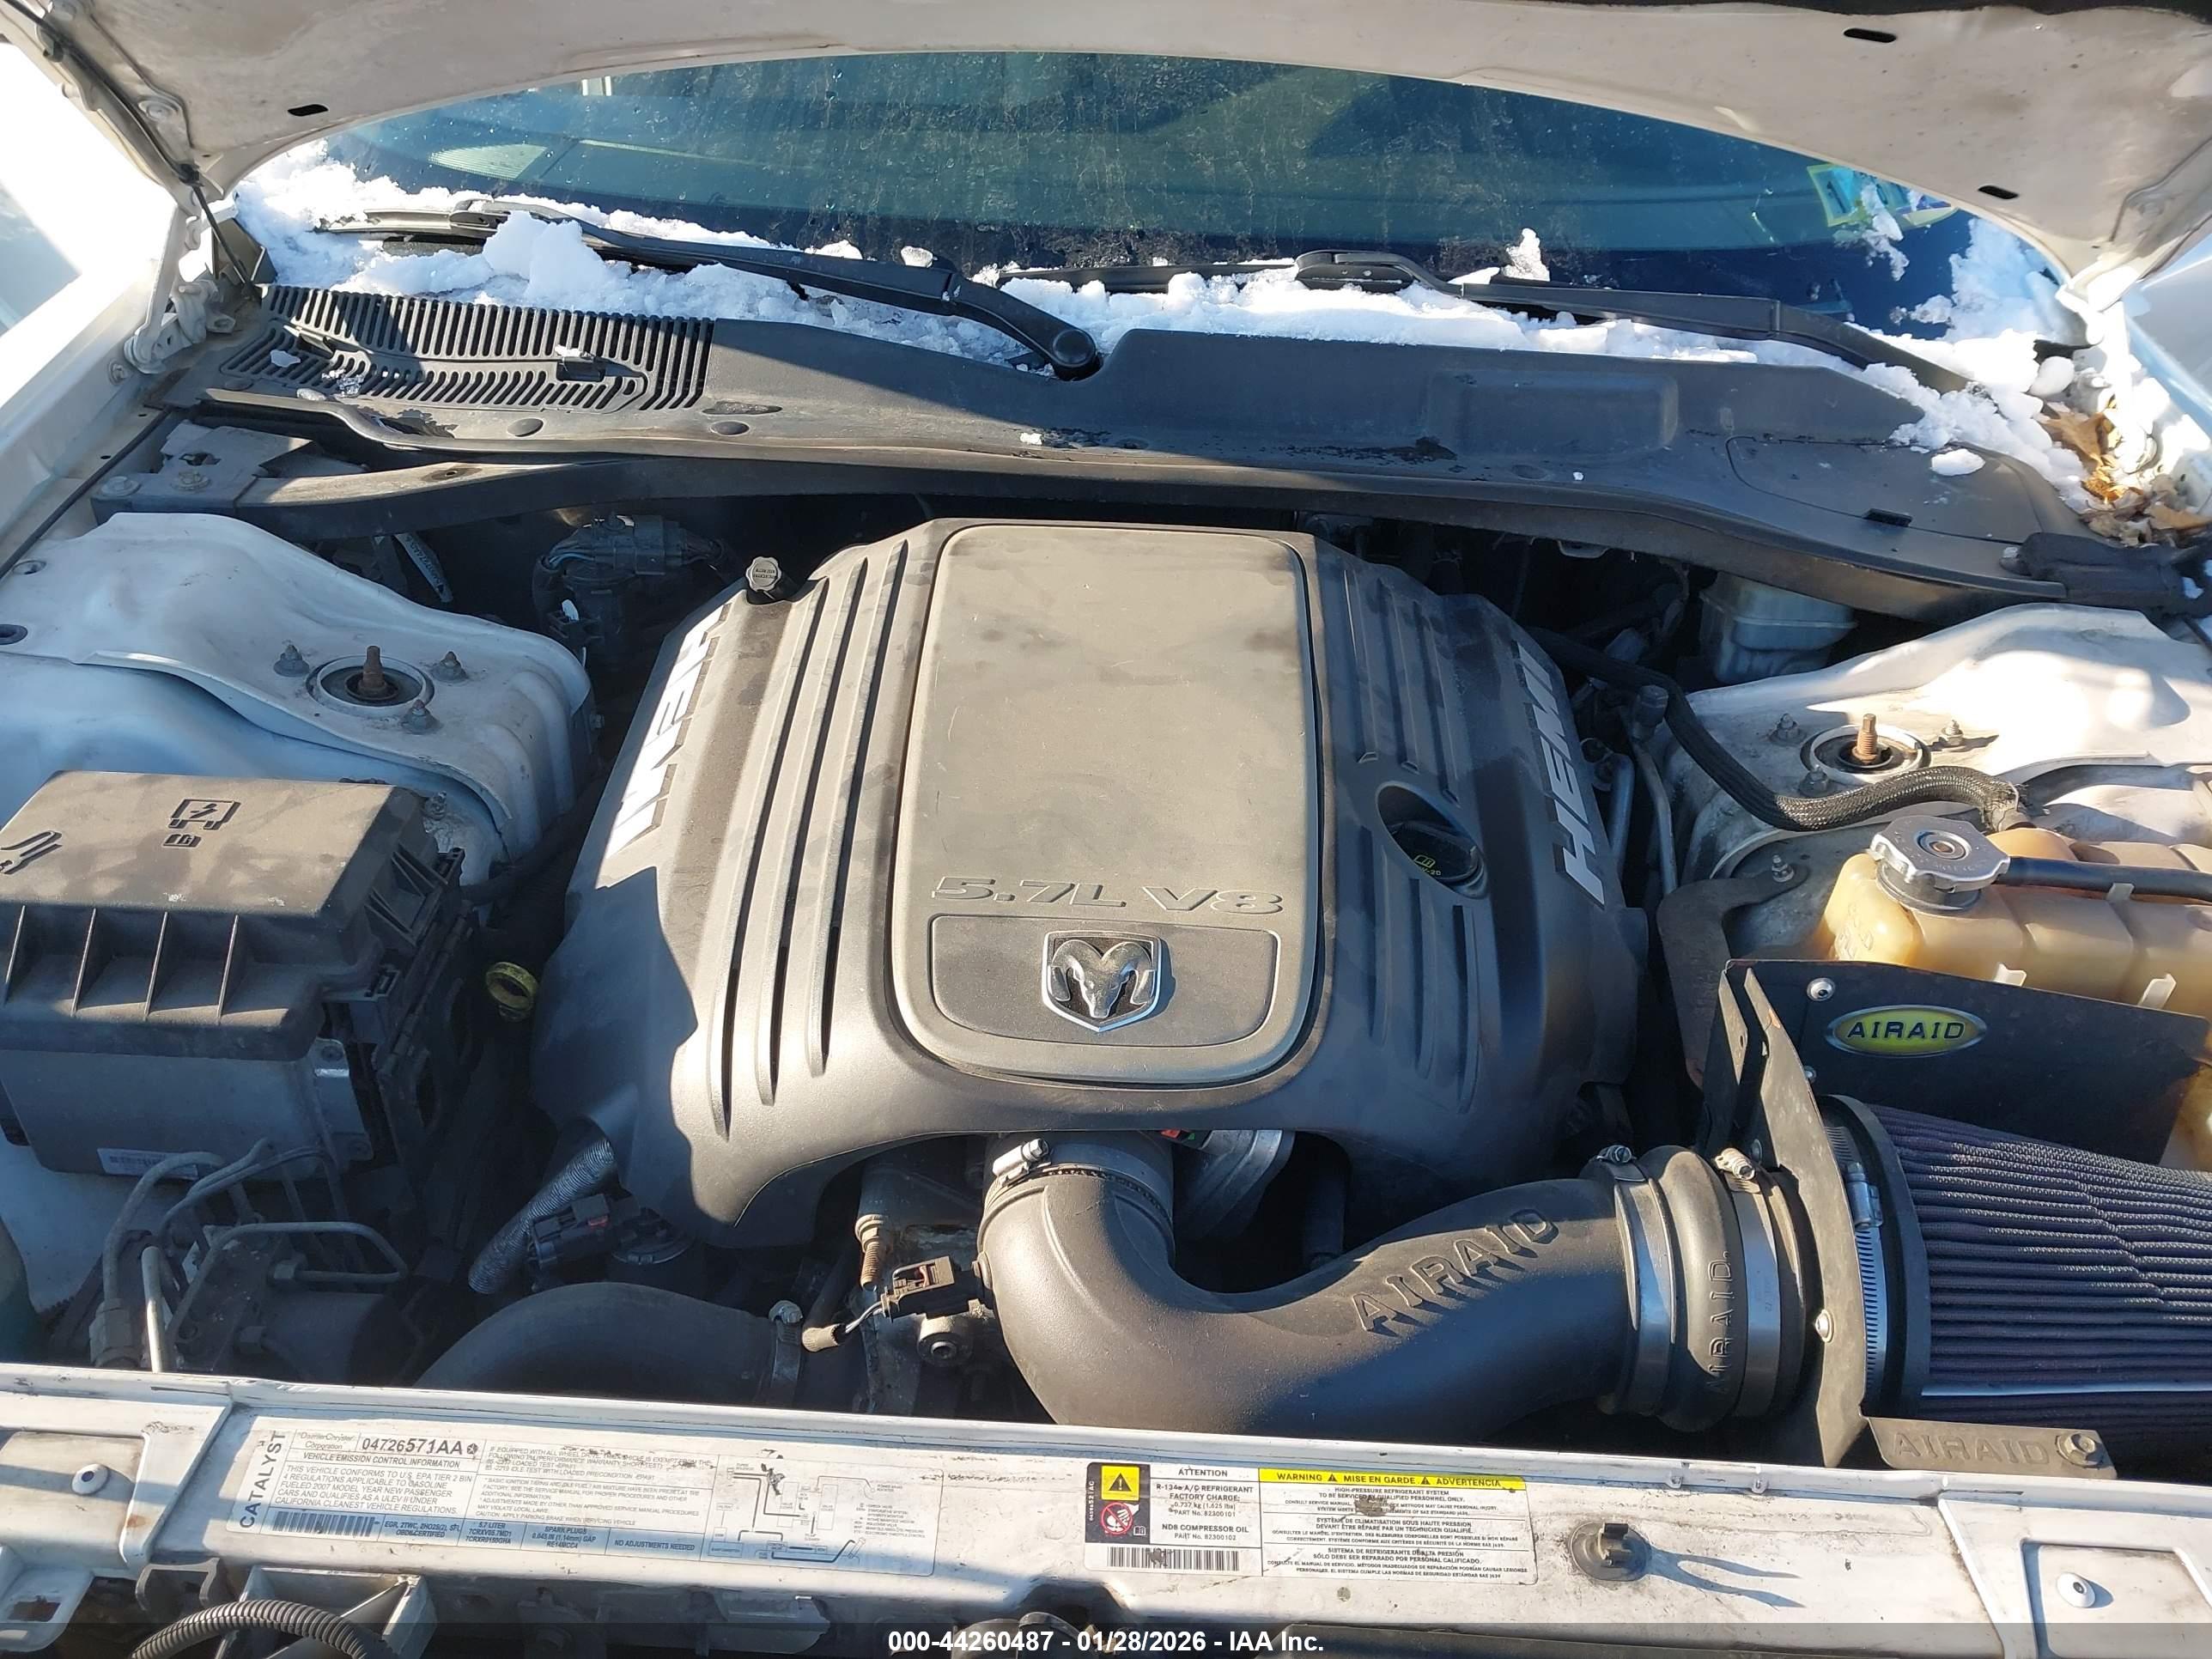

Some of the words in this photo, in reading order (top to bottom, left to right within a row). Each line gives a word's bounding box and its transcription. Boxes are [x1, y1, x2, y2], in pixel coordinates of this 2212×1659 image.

[932, 876, 1127, 908] 5.7L
[1142, 886, 1284, 915] V8
[1847, 1020, 1966, 1040] AIRAID
[1352, 1209, 1559, 1332] AIRAID
[304, 1441, 343, 1450] Corporation
[360, 1435, 465, 1455] 04726571AA
[1894, 1432, 2051, 1464] AIRAID
[302, 1451, 335, 1461] VEHICLE
[335, 1454, 371, 1462] EMISSION
[372, 1455, 408, 1465] CONTROL
[409, 1458, 460, 1468] INFORMATION
[285, 1464, 304, 1473] THIS
[306, 1466, 338, 1474] VEHICLE
[339, 1468, 385, 1477] CONFORMS
[1178, 1468, 1227, 1477] ATTENTION
[240, 1430, 286, 1528] CATALYST
[289, 1473, 344, 1483] REGULATIONS
[346, 1476, 392, 1486] APPLICABLE
[1383, 1475, 1415, 1484] GARDE
[1435, 1477, 1500, 1486] ADVERTENCIA
[280, 1480, 312, 1489] FUELED
[404, 1488, 453, 1498] PASSENGER
[319, 1491, 360, 1500] QUALIFIES
[1201, 1485, 1253, 1493] REFRIGERANT
[274, 1497, 321, 1506] CALIFORNIA
[322, 1499, 365, 1509] CLEANEST
[366, 1502, 399, 1510] VEHICLE
[1180, 1523, 1233, 1532] COMPRESSOR
[624, 1540, 669, 1549] ADJUSTMENTS
[670, 1542, 695, 1551] NEEDED
